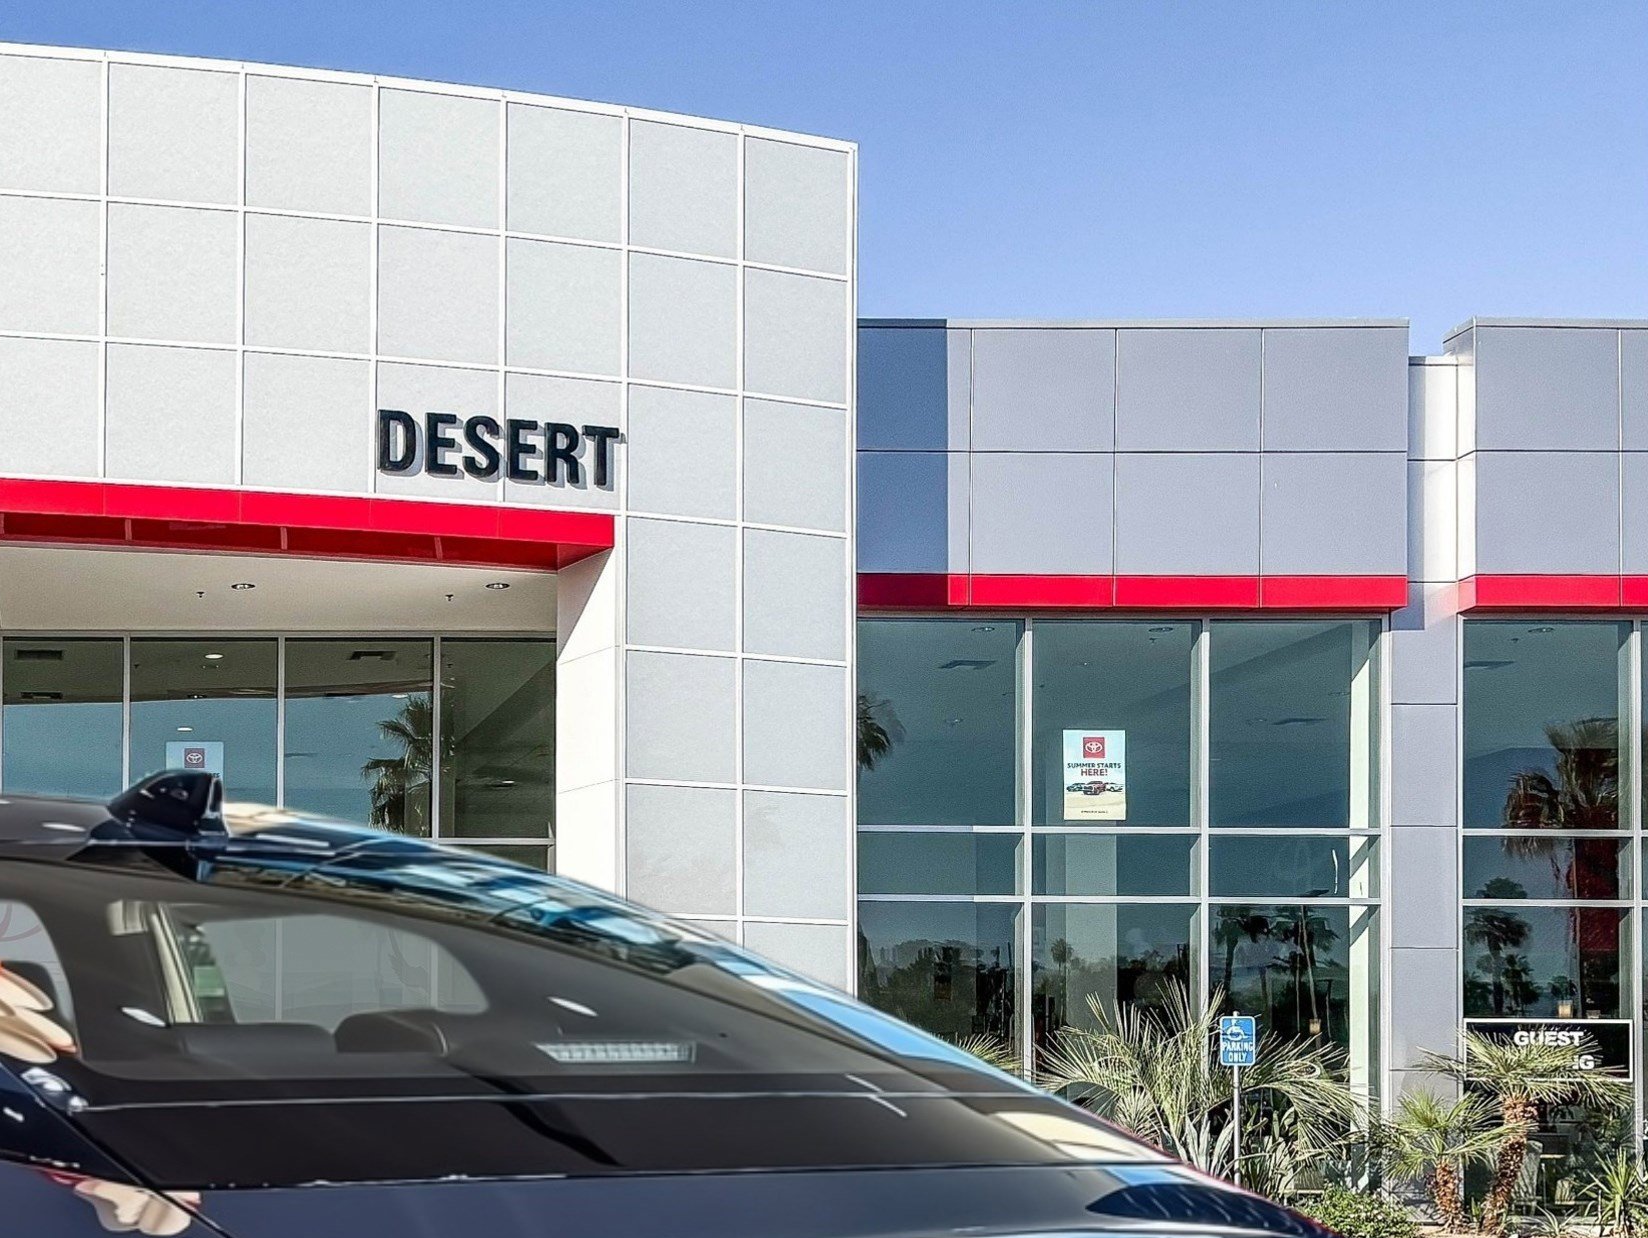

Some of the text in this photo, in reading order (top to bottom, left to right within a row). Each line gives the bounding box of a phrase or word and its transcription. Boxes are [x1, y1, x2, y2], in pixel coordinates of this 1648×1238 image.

[377, 409, 621, 488] DESERT
[1514, 1031, 1584, 1046] GUEST
[1222, 1041, 1254, 1052] PARKING
[1228, 1052, 1248, 1063] ONLY
